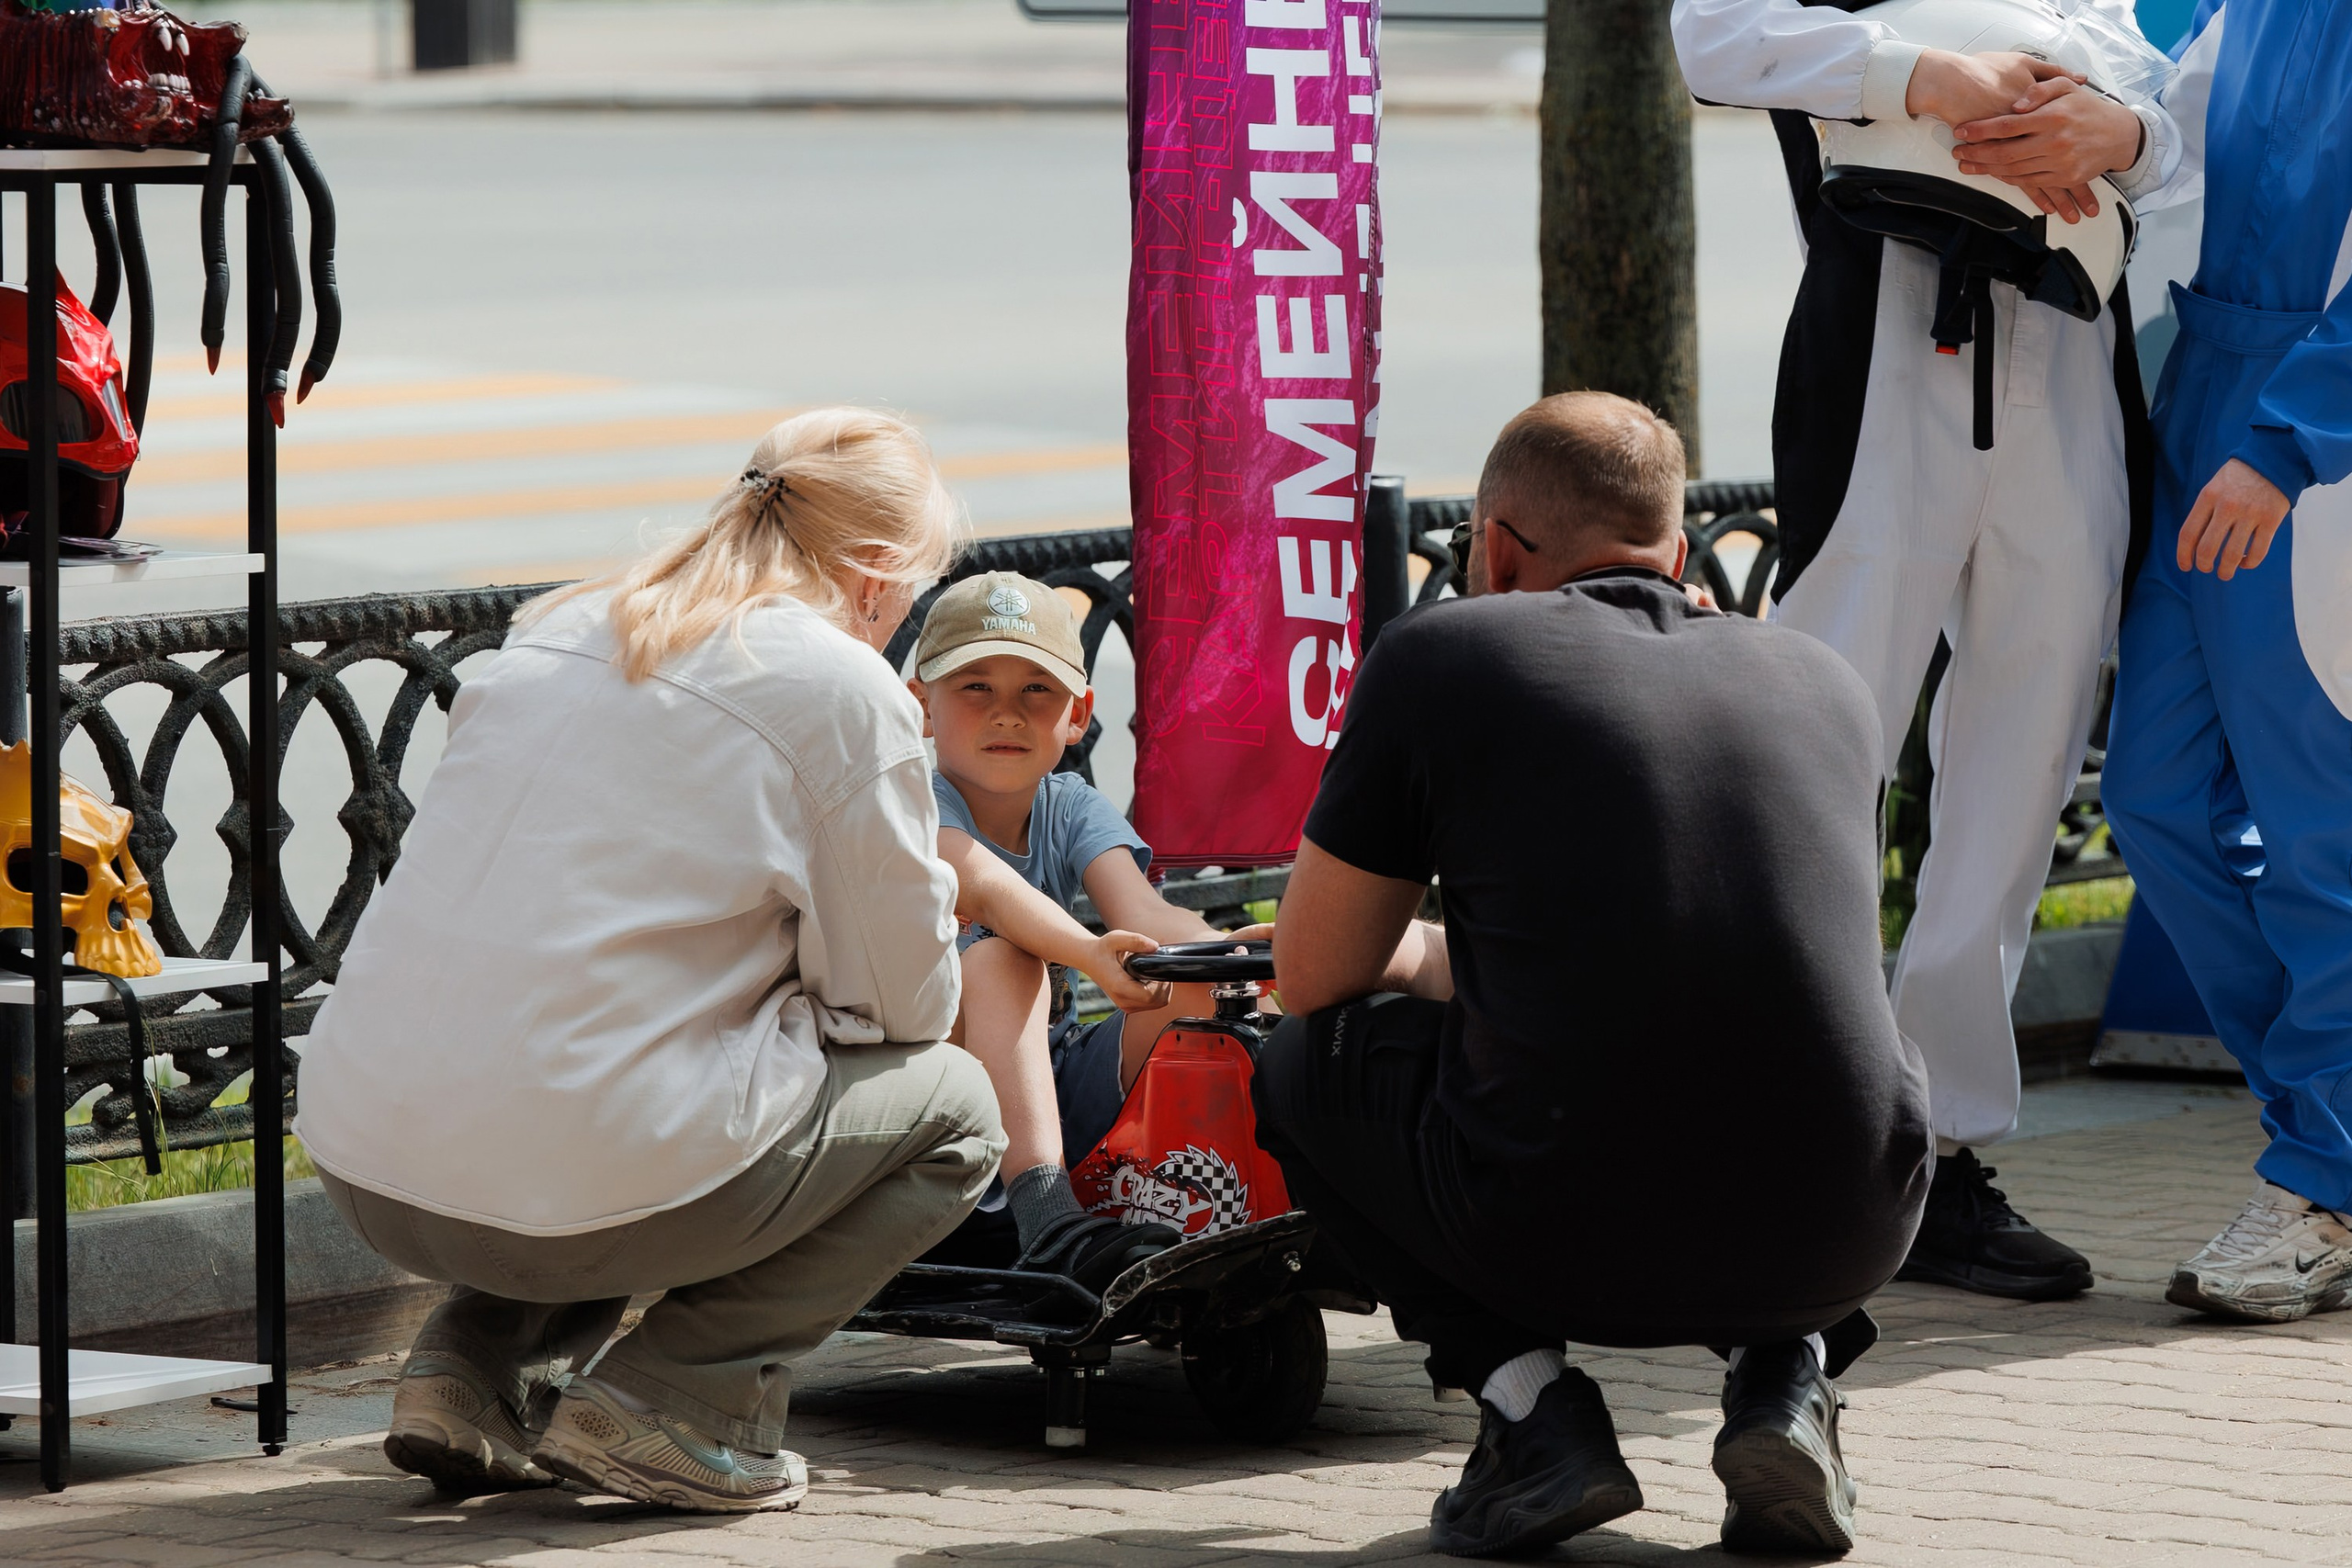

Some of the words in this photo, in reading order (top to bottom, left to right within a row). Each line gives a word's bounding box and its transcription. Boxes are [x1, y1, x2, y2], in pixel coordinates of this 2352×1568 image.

[981, 617, 1036, 636] YAMAHA
[1134, 0, 1204, 740] СЕМЕЙН
[1193, 0, 1266, 748] КАРТИНГ-ЦЕ
[1232, 0, 1357, 749] СЕМЕЙН
[1110, 1164, 1213, 1226] CRAZY
